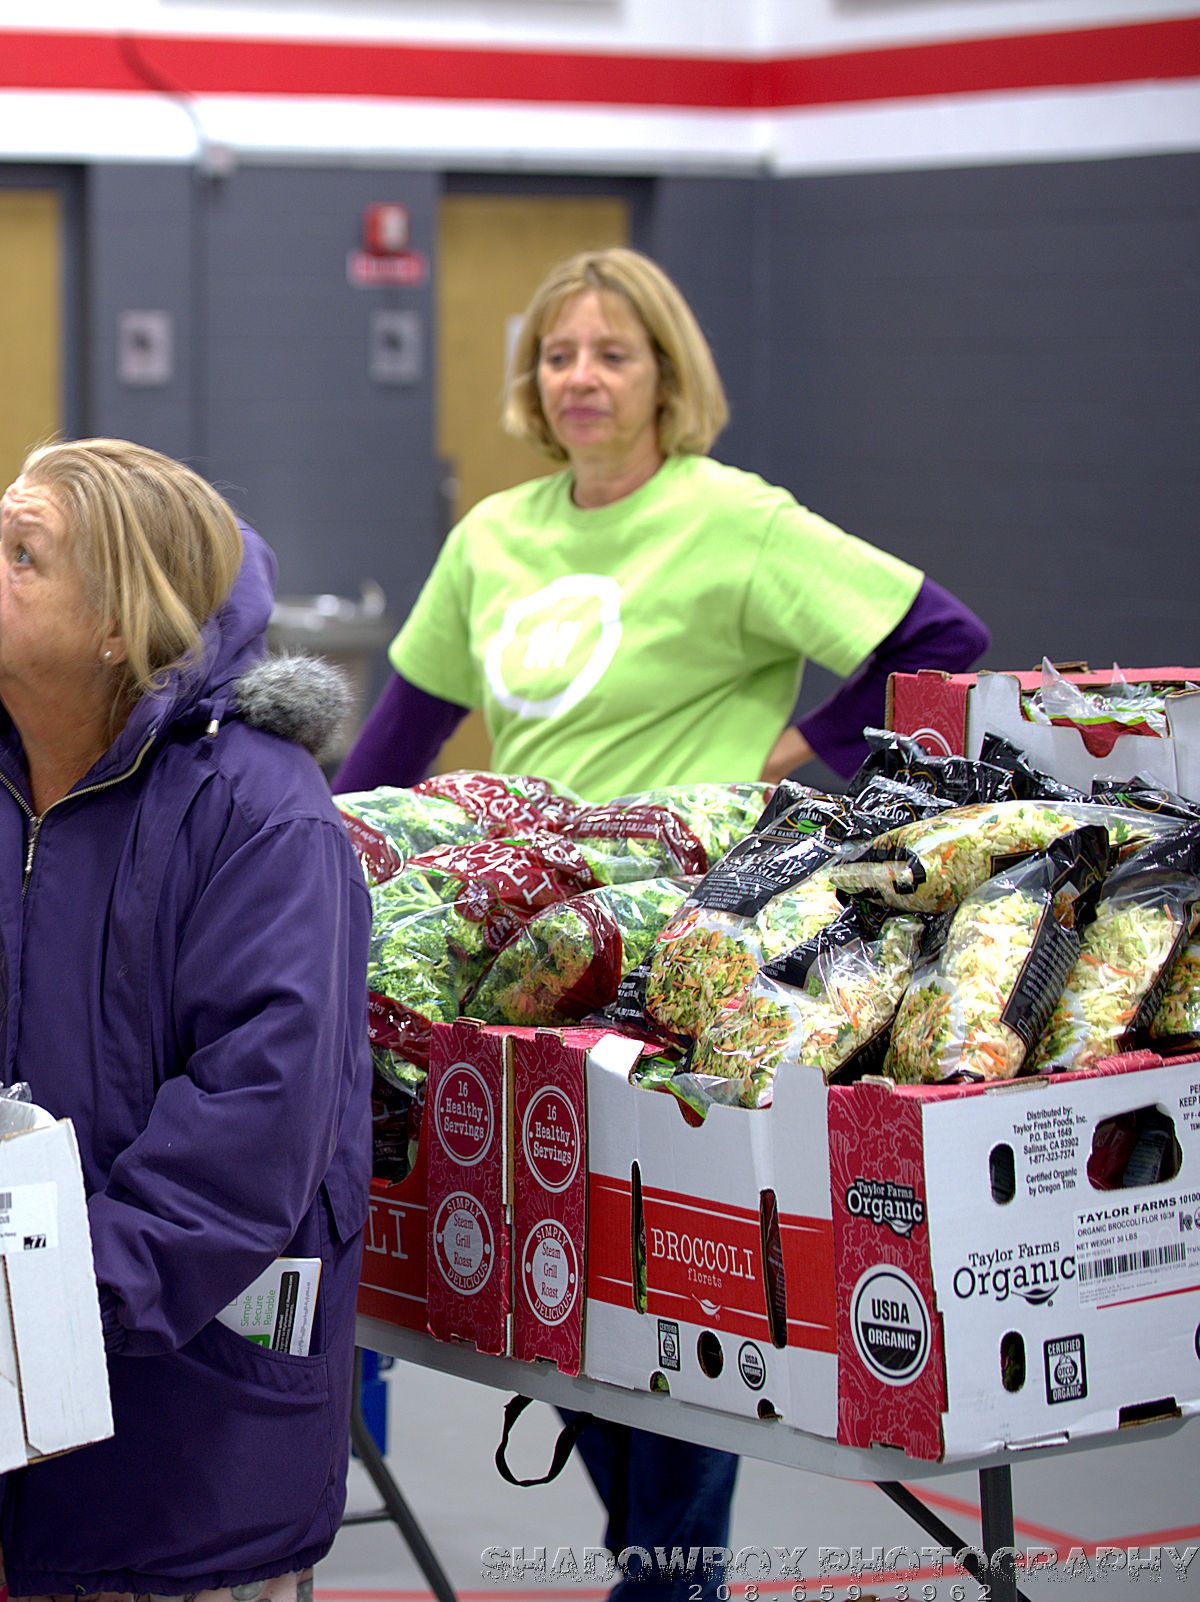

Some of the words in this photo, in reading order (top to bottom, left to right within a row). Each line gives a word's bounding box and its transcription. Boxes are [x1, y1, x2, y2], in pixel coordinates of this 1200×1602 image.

[457, 1081, 469, 1097] 16
[445, 1097, 483, 1121] Healthy
[547, 1104, 557, 1120] 16
[1027, 1108, 1062, 1121] Distributed
[1063, 1106, 1073, 1117] by:
[443, 1115, 485, 1139] Servings
[1013, 1121, 1032, 1135] Taylor
[1033, 1118, 1052, 1131] Fresh
[1053, 1115, 1075, 1128] Foods,
[1076, 1114, 1087, 1124] Inc.
[535, 1123, 571, 1148] Healthy
[1029, 1133, 1042, 1142] P.O.
[1043, 1131, 1056, 1140] Box
[533, 1142, 572, 1165] Servings
[1023, 1143, 1048, 1155] Salinas,
[1049, 1140, 1059, 1149] CA
[1026, 1170, 1052, 1184] Certified
[1053, 1167, 1078, 1180] Organic
[856, 1181, 885, 1197] Taylor
[887, 1184, 913, 1199] Farms
[1029, 1186, 1037, 1196] by
[1038, 1182, 1061, 1195] Oregon
[1062, 1180, 1076, 1191] Tilth
[447, 1201, 482, 1219] SIMPLY
[847, 1189, 923, 1223] Organic
[1078, 1207, 1130, 1224] TAYLOR
[1133, 1197, 1176, 1214] FARMS
[453, 1214, 474, 1230] Steam
[1078, 1224, 1107, 1238] ORGANIC
[1108, 1218, 1141, 1230] BROCCOLI
[455, 1233, 471, 1248] Grill
[535, 1226, 568, 1246] SIMPLY
[1076, 1241, 1089, 1251] NET
[1090, 1237, 1115, 1249] WEIGHT
[1125, 1232, 1138, 1241] LBS
[453, 1251, 473, 1269] Roast
[542, 1243, 561, 1260] Steam
[651, 1228, 755, 1280] BROCCOLI
[968, 1248, 1014, 1270] Taylor
[1018, 1240, 1060, 1259] Farms
[447, 1260, 489, 1288] DELICIOUS
[543, 1263, 558, 1278] Grill
[688, 1268, 722, 1288] florets
[953, 1256, 1076, 1301] Organic
[541, 1282, 559, 1299] Roast
[241, 1295, 252, 1327] Simple
[253, 1295, 263, 1326] Secure
[264, 1289, 275, 1326] Reliable
[534, 1289, 573, 1320] DELICIOUS
[872, 1298, 910, 1324] USDA
[868, 1328, 916, 1351] ORGANIC
[1047, 1338, 1080, 1355] CERTIFIED
[744, 1353, 759, 1365] USDA
[1052, 1384, 1082, 1401] ORGANIC
